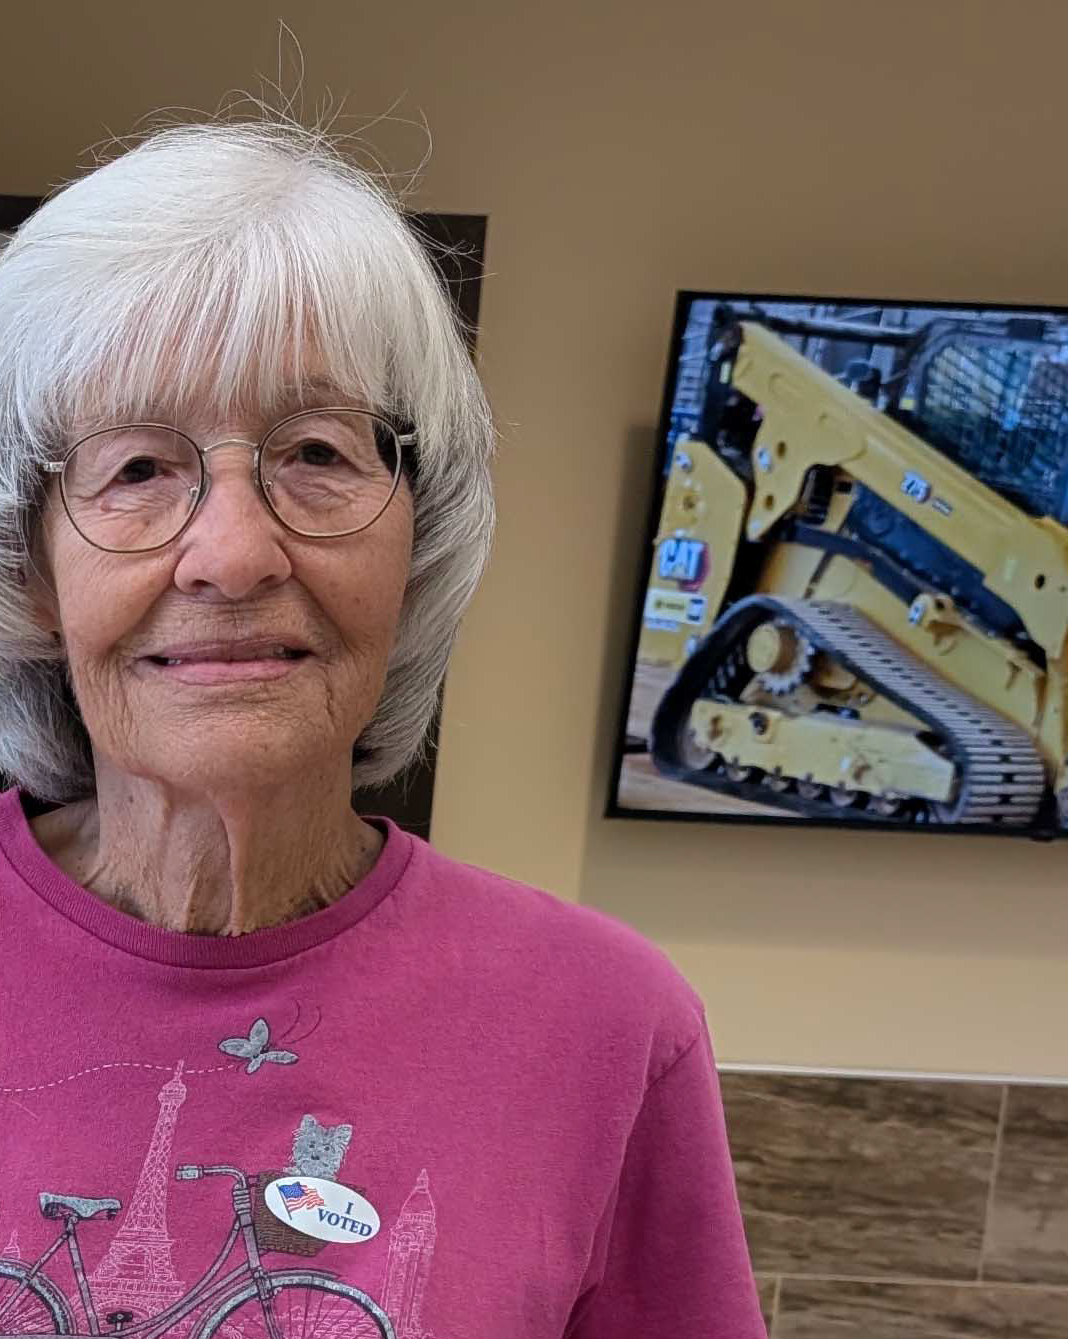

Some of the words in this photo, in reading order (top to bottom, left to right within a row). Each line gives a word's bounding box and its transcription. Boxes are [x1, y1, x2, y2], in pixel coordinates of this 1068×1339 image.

[658, 538, 705, 580] CAT
[318, 1207, 373, 1237] VOTED
[345, 1201, 354, 1215] I
